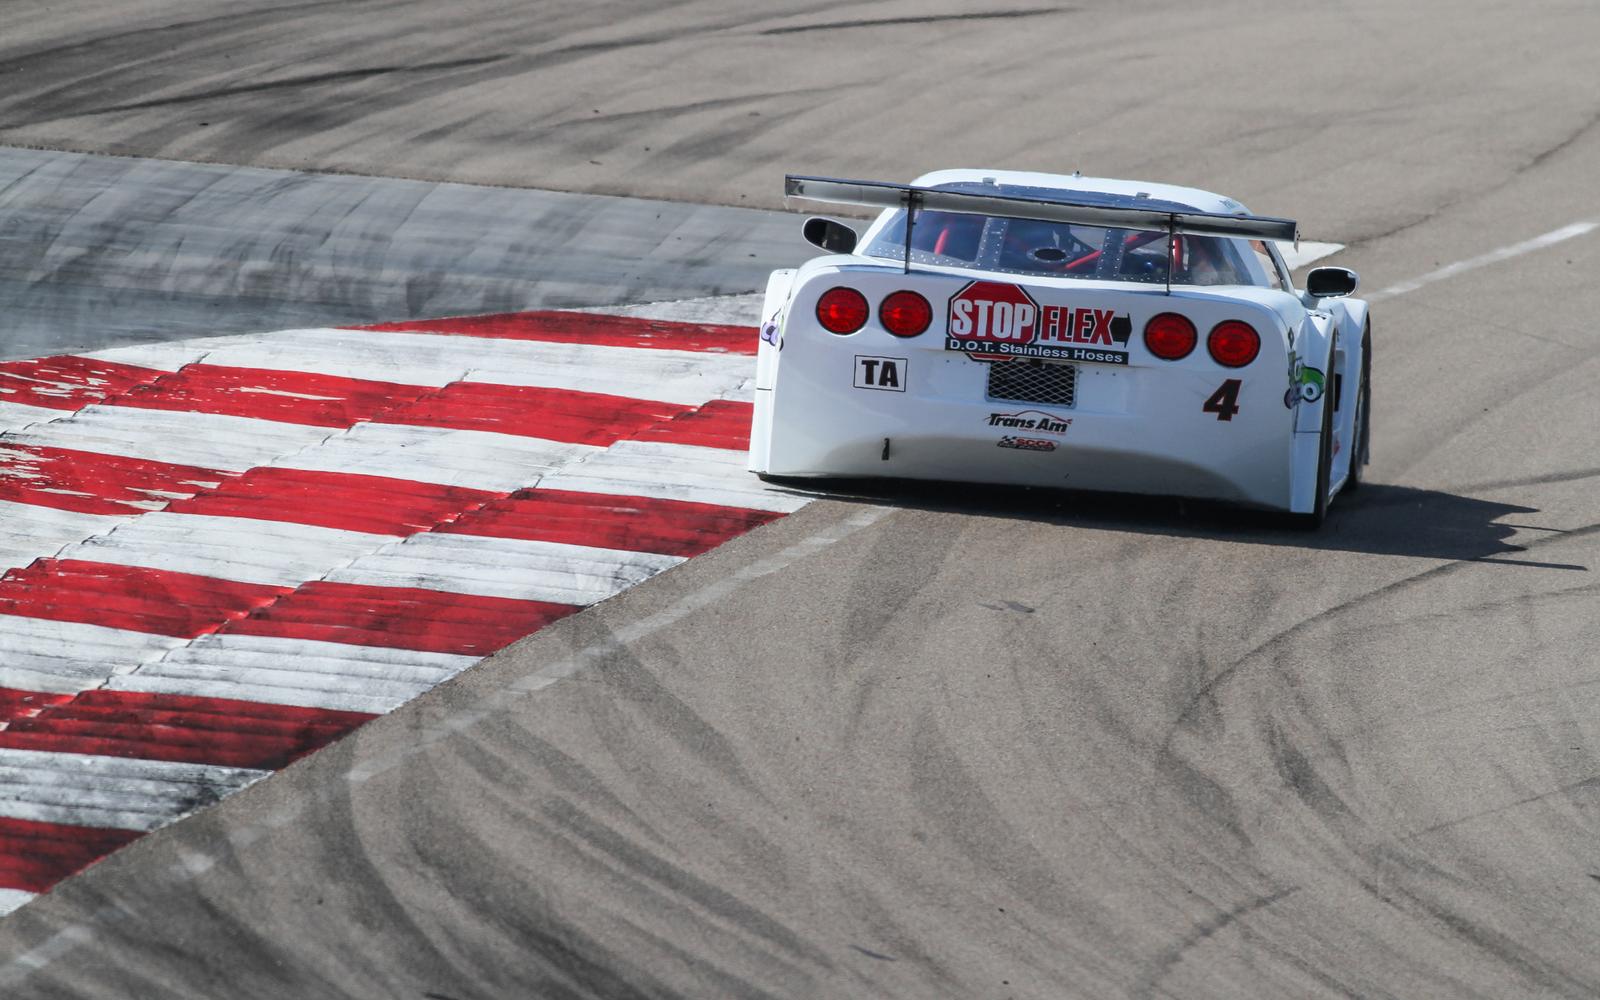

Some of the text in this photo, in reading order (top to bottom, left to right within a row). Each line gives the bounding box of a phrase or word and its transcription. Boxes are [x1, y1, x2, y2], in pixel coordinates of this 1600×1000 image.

[952, 298, 1115, 345] STOP FLEX
[949, 339, 1123, 363] D.O.T. Stainless Hoses
[861, 359, 899, 387] TA
[1202, 378, 1242, 422] 4
[988, 413, 1035, 428] Trans
[1035, 418, 1068, 432] Am
